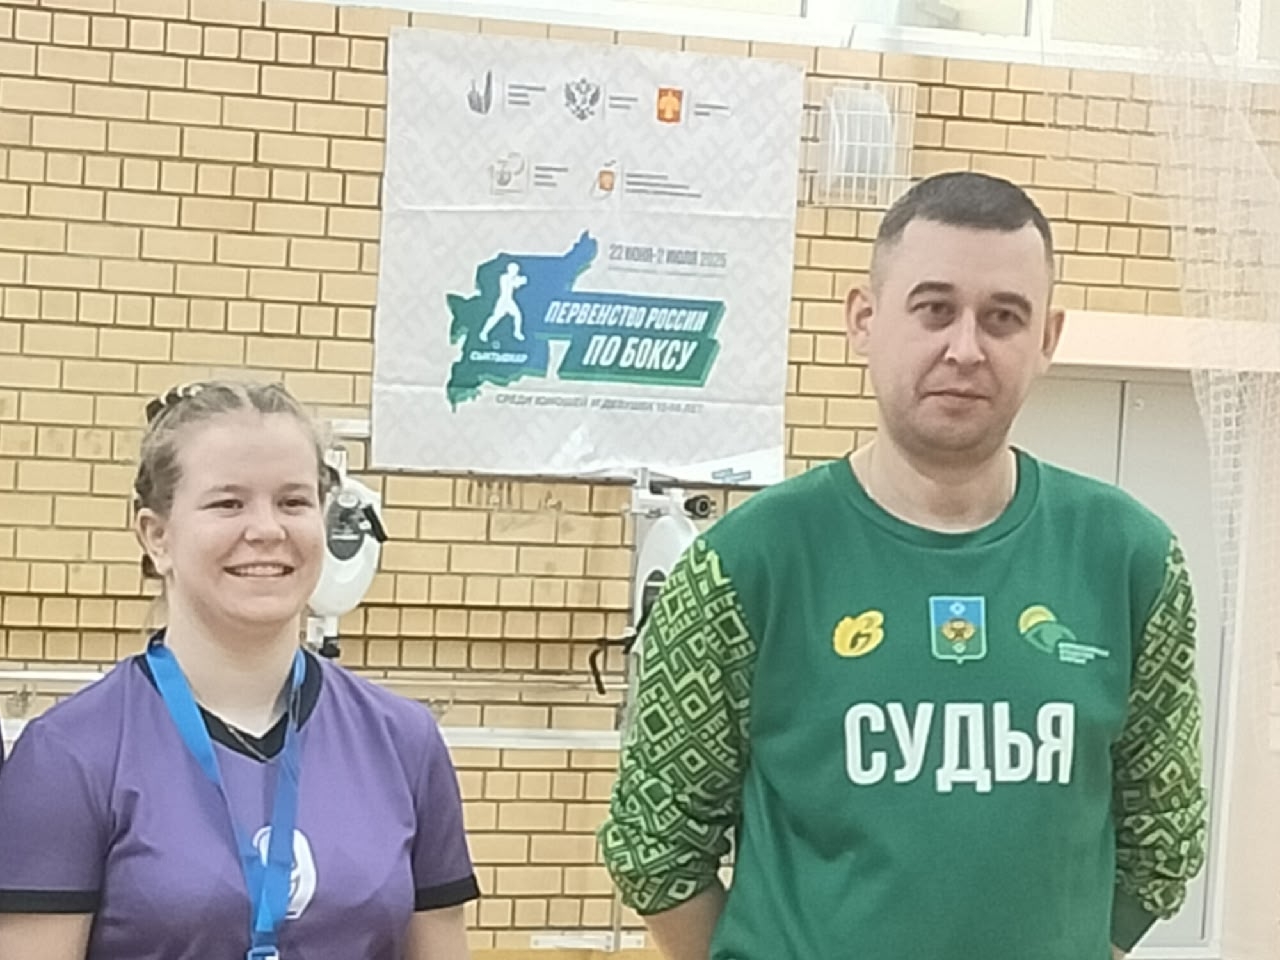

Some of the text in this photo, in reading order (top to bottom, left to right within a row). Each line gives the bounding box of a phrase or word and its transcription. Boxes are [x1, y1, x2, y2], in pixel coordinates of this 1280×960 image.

[544, 301, 709, 332] ПЕРВЕНСТВО РОССИИ
[582, 334, 698, 372] ПО БОКСУ
[844, 702, 1075, 793] СУДЬЯ
